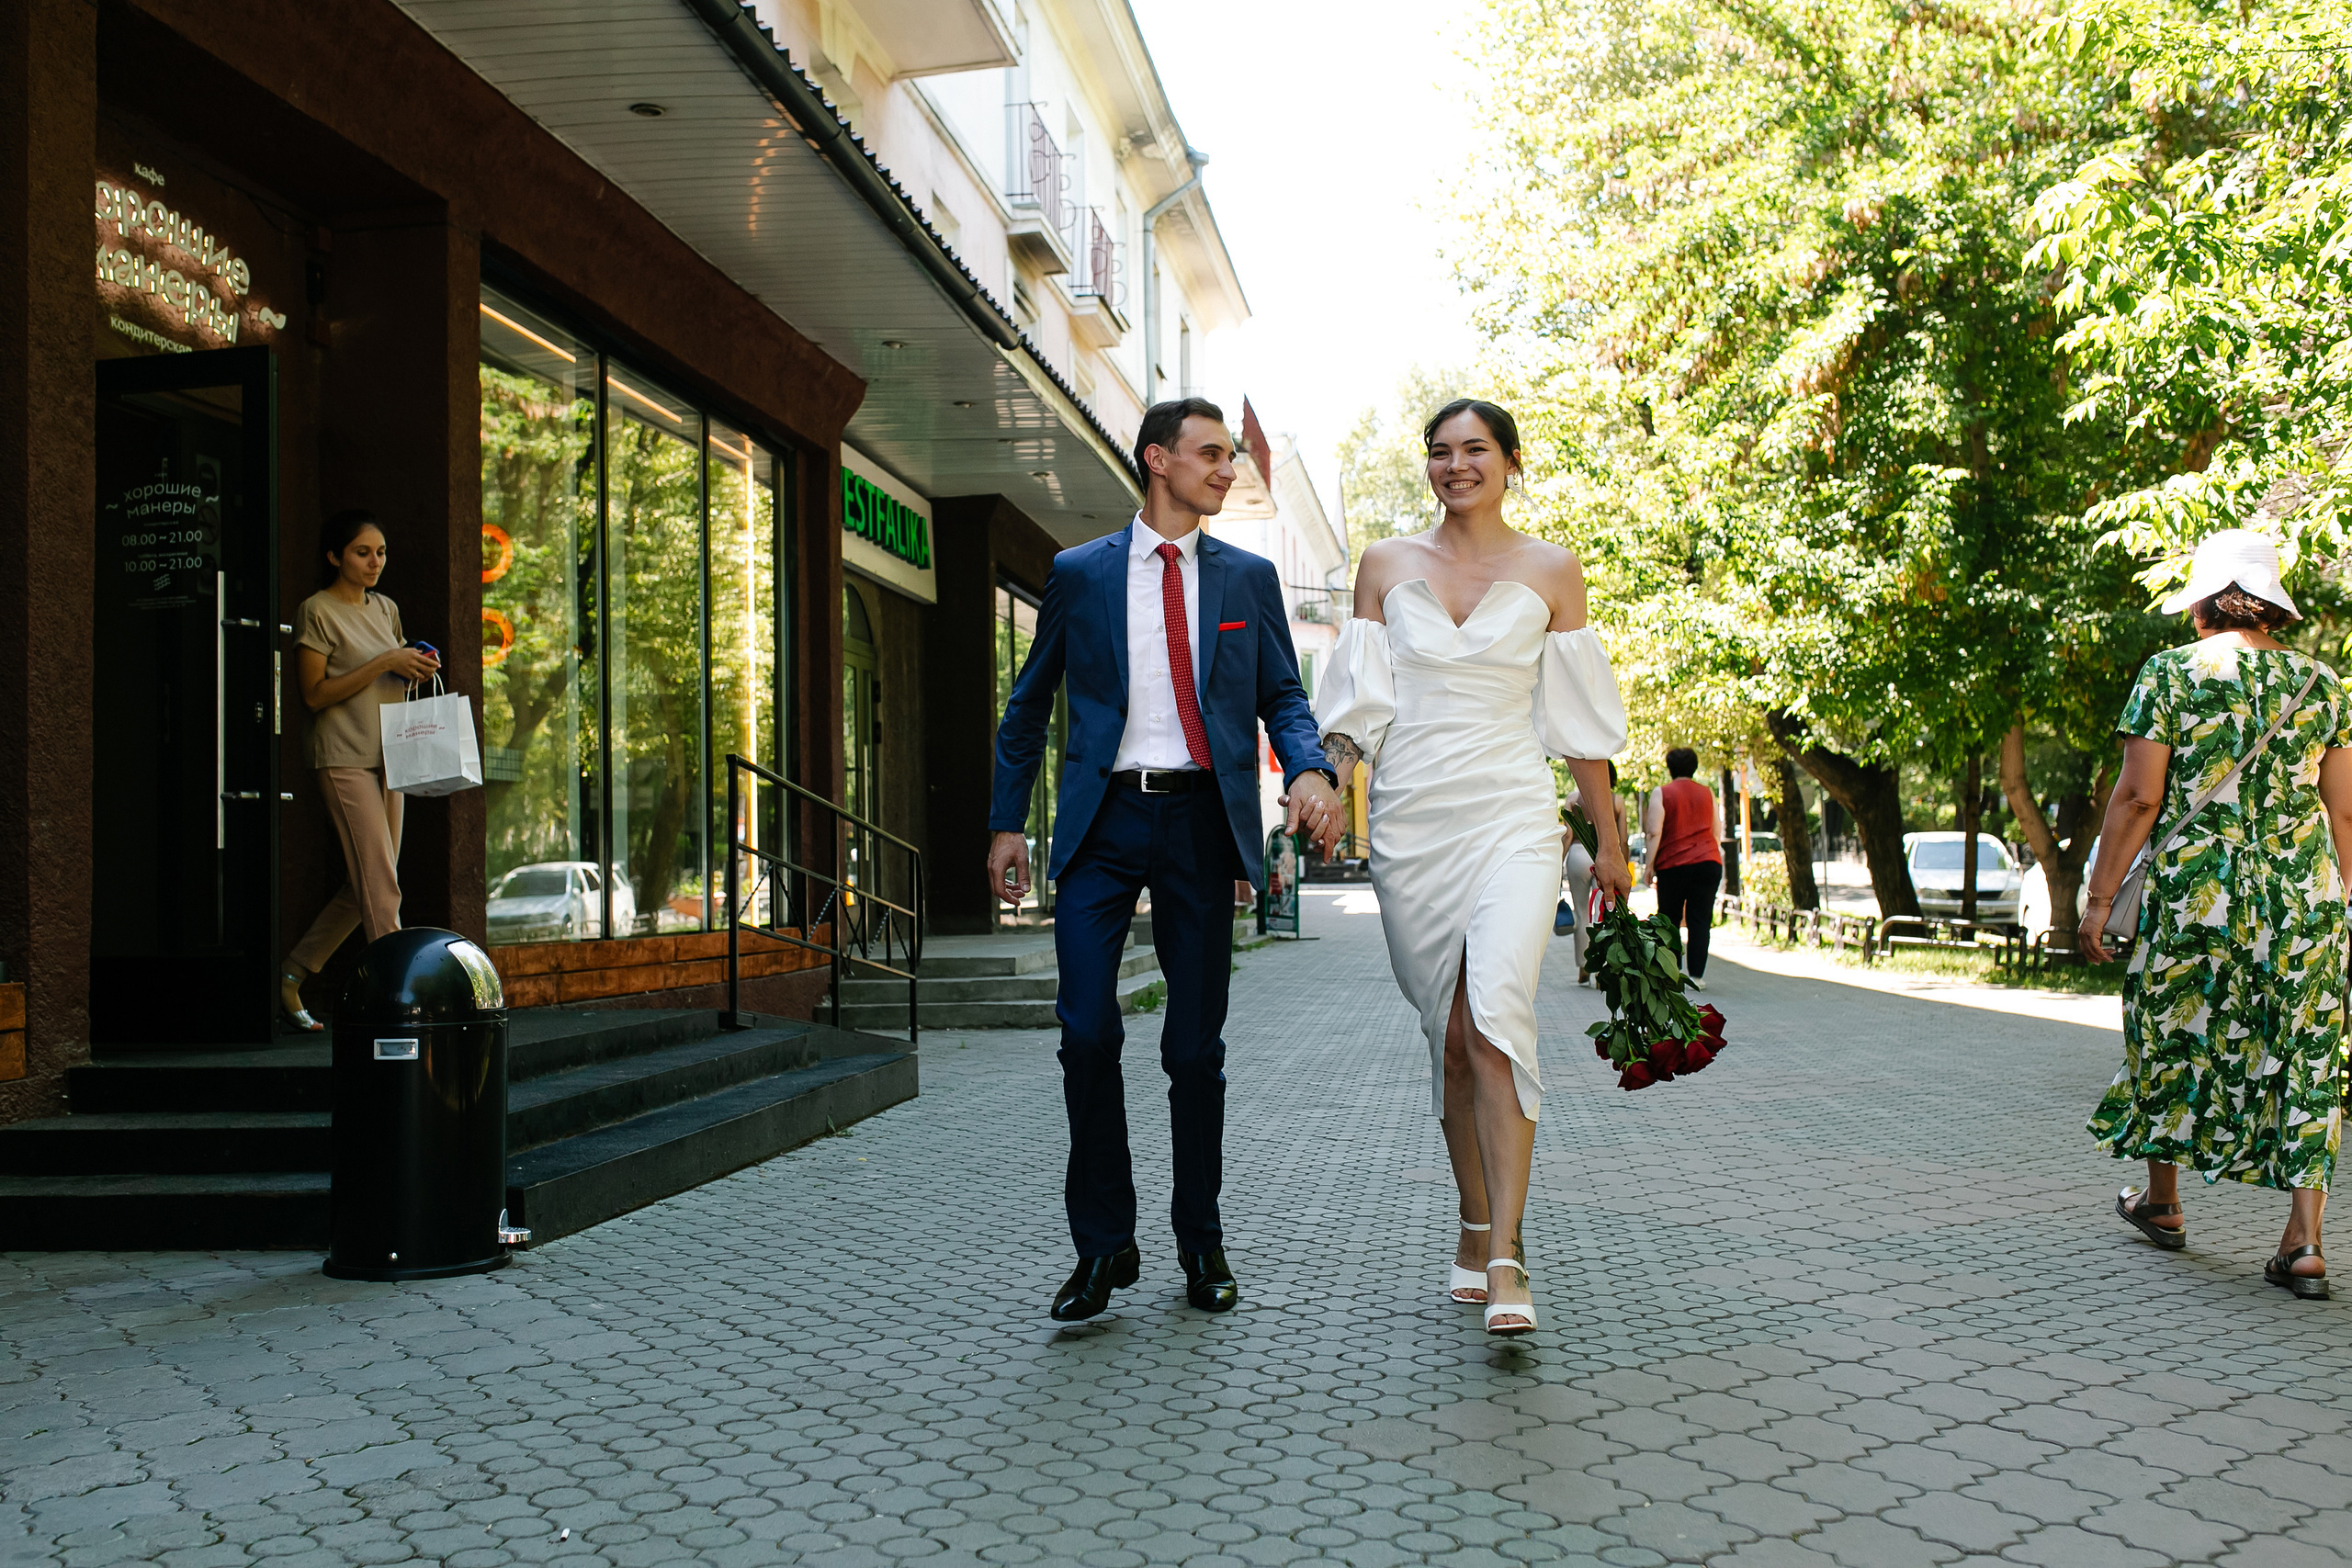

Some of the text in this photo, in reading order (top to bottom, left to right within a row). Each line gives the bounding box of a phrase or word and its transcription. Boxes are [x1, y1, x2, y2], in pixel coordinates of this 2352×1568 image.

[134, 163, 164, 186] кафе
[96, 181, 250, 296] орошие
[123, 483, 201, 502] хорошие
[127, 501, 196, 519] манеры
[841, 466, 932, 570] ESTFALIKA
[122, 533, 156, 547] 08.00
[169, 530, 202, 544] 21.00
[125, 559, 156, 572] 10.00
[169, 557, 202, 570] 21.00
